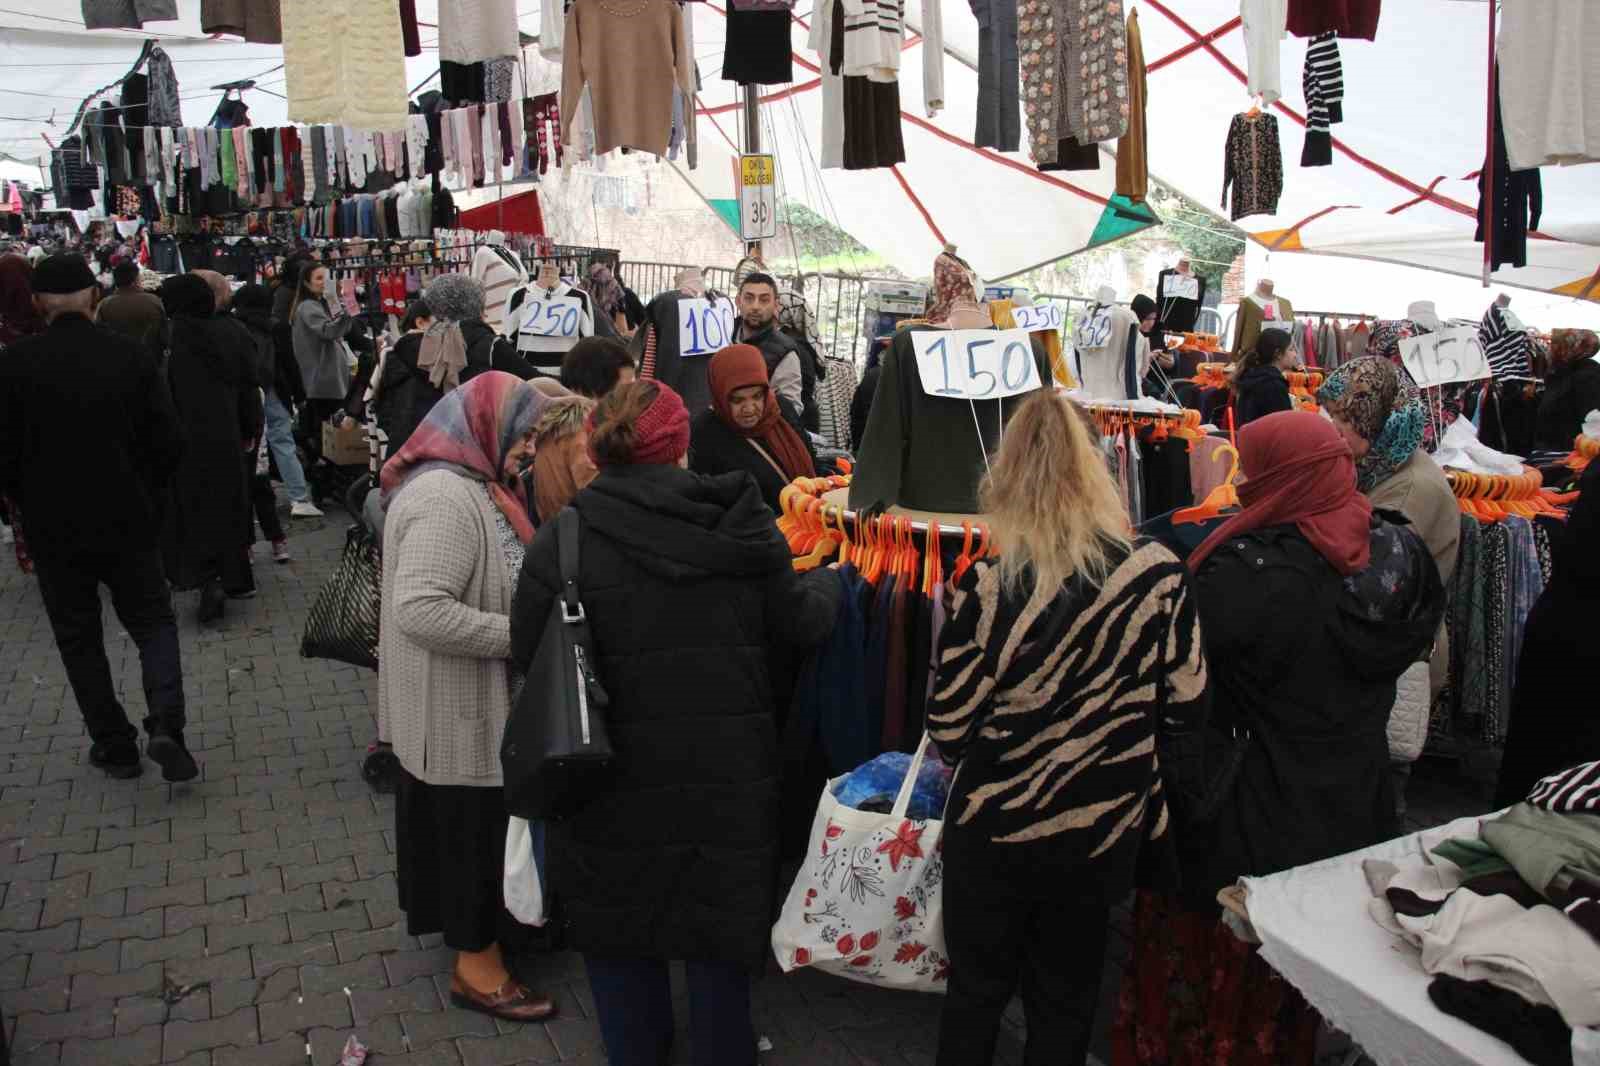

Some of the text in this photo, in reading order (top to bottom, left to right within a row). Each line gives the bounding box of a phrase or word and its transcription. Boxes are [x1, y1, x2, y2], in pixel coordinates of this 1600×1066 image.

[752, 201, 767, 224] 30
[523, 301, 577, 336] 250
[1016, 305, 1060, 328] 250
[926, 337, 1031, 396] 150
[1408, 337, 1484, 382] 150
